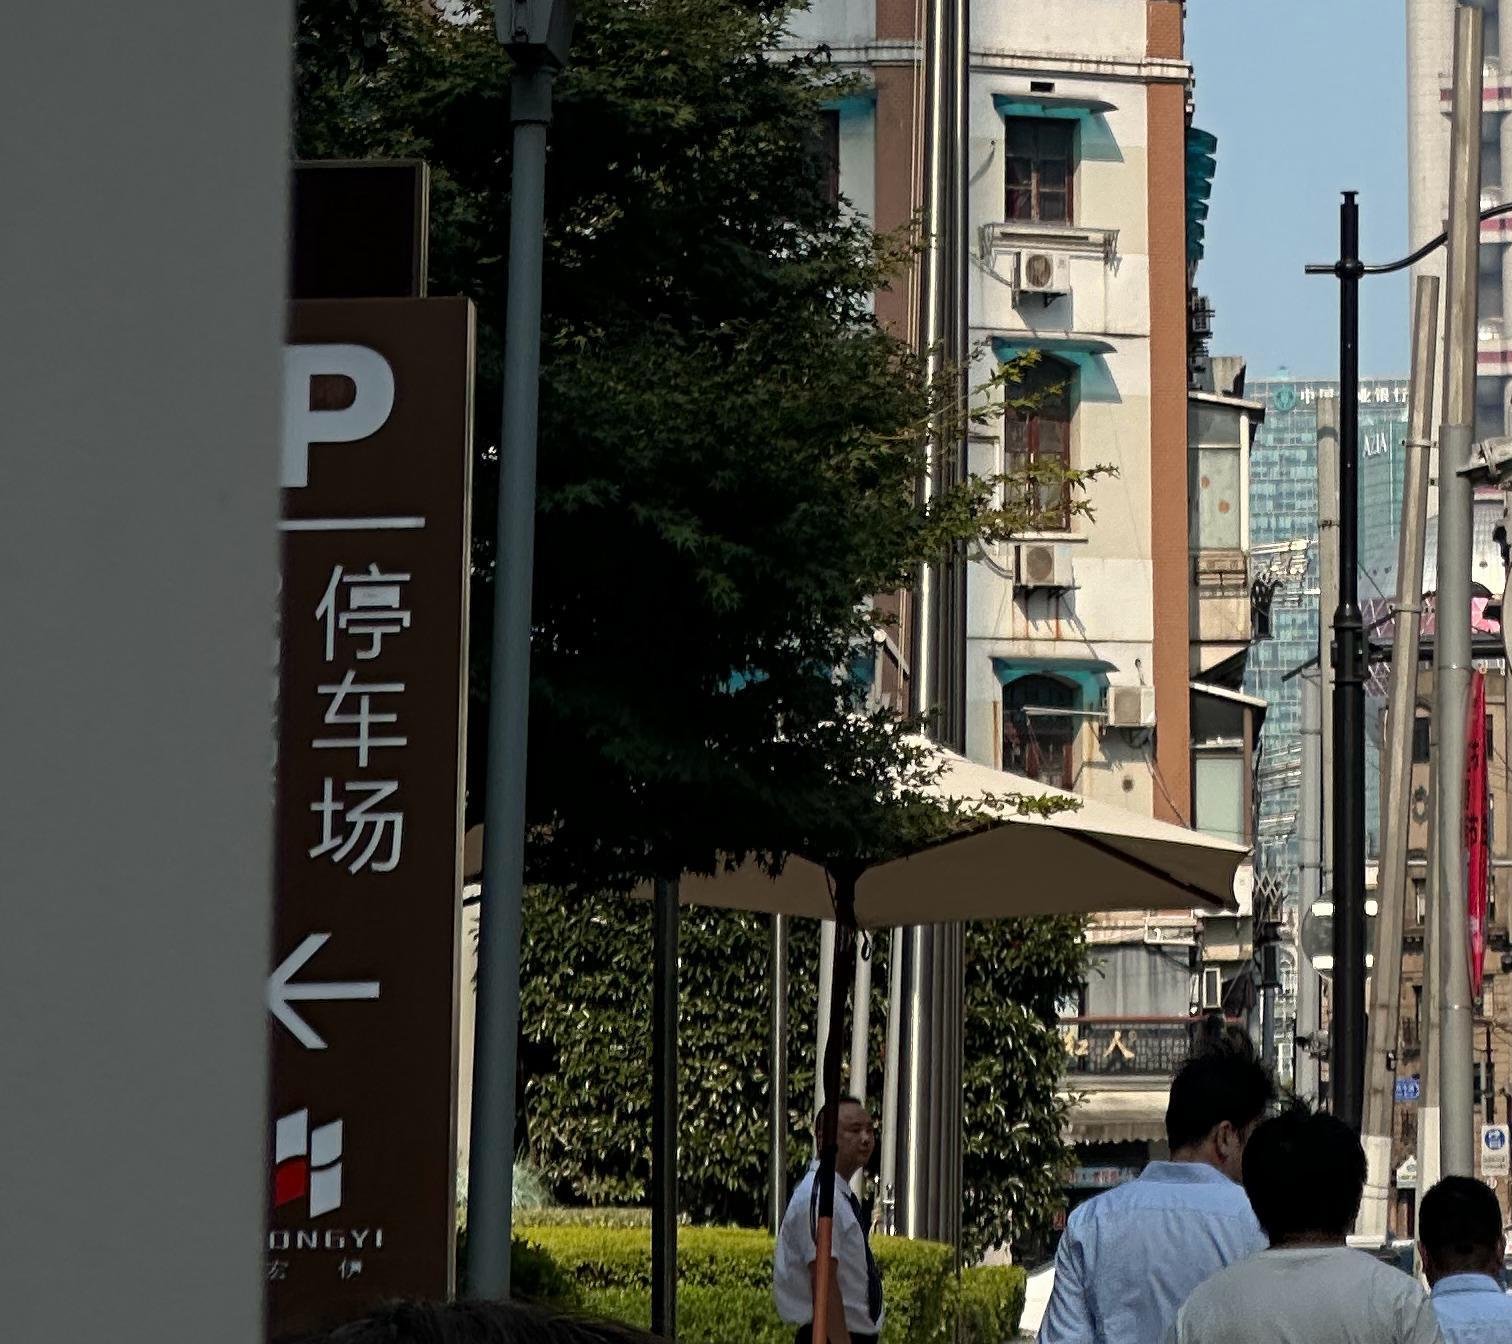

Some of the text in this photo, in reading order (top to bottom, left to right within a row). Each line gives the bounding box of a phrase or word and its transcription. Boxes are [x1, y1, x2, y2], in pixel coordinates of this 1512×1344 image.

[279, 343, 396, 489] P
[1300, 386, 1408, 405] 中国业银行
[308, 562, 414, 876] 停车场
